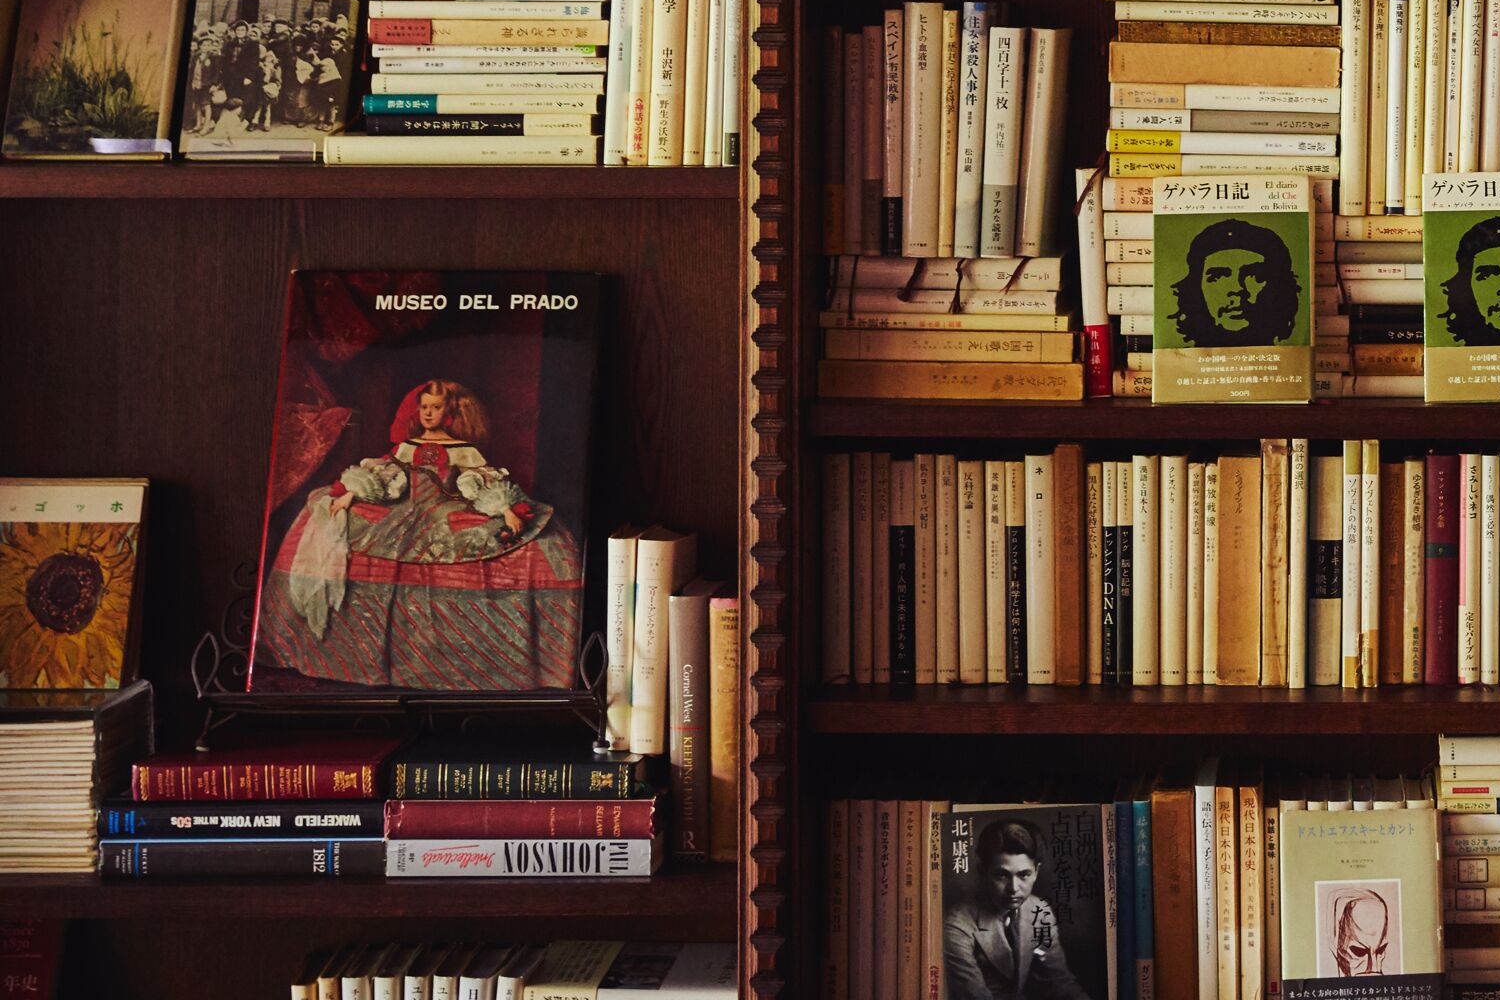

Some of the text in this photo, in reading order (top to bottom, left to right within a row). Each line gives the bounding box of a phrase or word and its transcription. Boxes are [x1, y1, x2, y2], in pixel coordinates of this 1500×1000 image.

[996, 37, 1010, 110] 四百字十一枚
[1163, 183, 1250, 200] ゲバラ日記
[1265, 181, 1298, 189] El diario
[1272, 202, 1298, 210] Bolivia
[375, 294, 579, 311] MUSEO DEL PRADO
[1035, 466, 1044, 500] ネロ
[1104, 582, 1114, 625] DNA
[220, 816, 253, 827] YORK
[254, 816, 281, 827] NEW
[294, 815, 362, 827] WAKEFIELD
[313, 849, 325, 872] 1812
[503, 842, 604, 873] JOHNSON
[610, 842, 628, 873] PAUL
